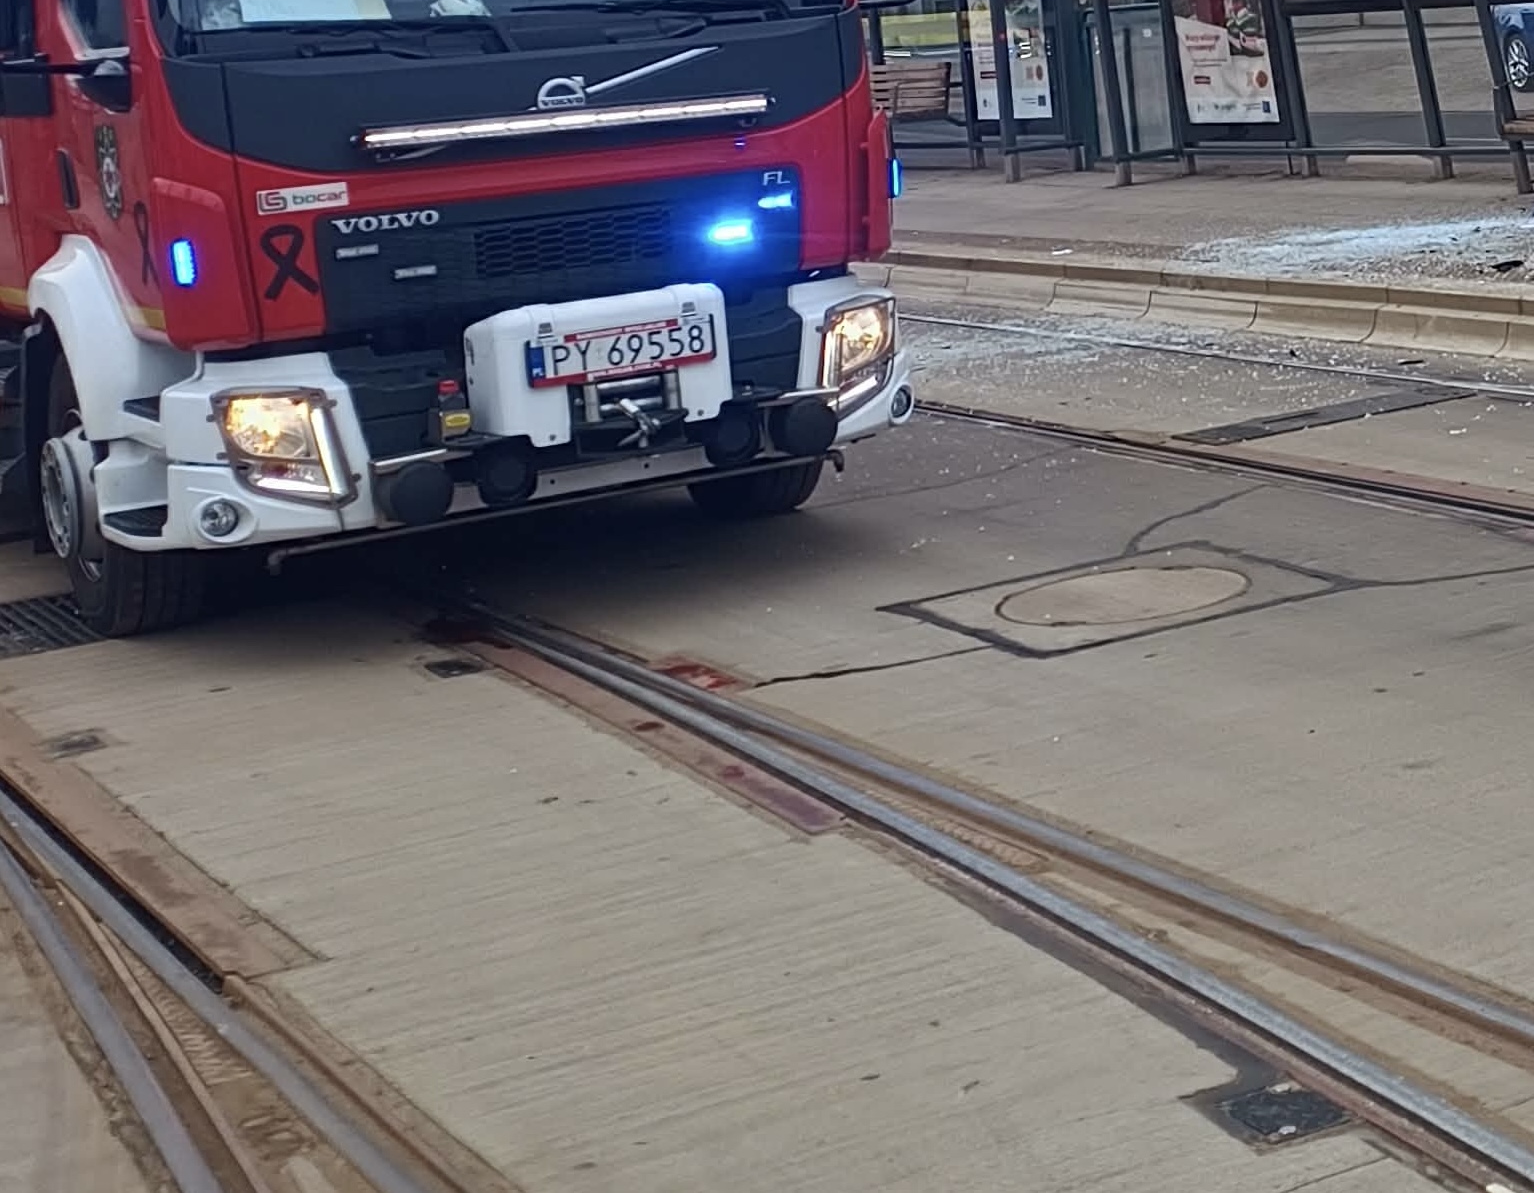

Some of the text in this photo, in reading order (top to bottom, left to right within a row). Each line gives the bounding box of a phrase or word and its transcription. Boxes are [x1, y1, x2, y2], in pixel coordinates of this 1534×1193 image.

[763, 171, 790, 186] FL
[292, 190, 345, 205] bocar
[331, 210, 439, 234] VOLVO
[552, 340, 591, 375] PY
[607, 325, 705, 366] 69558
